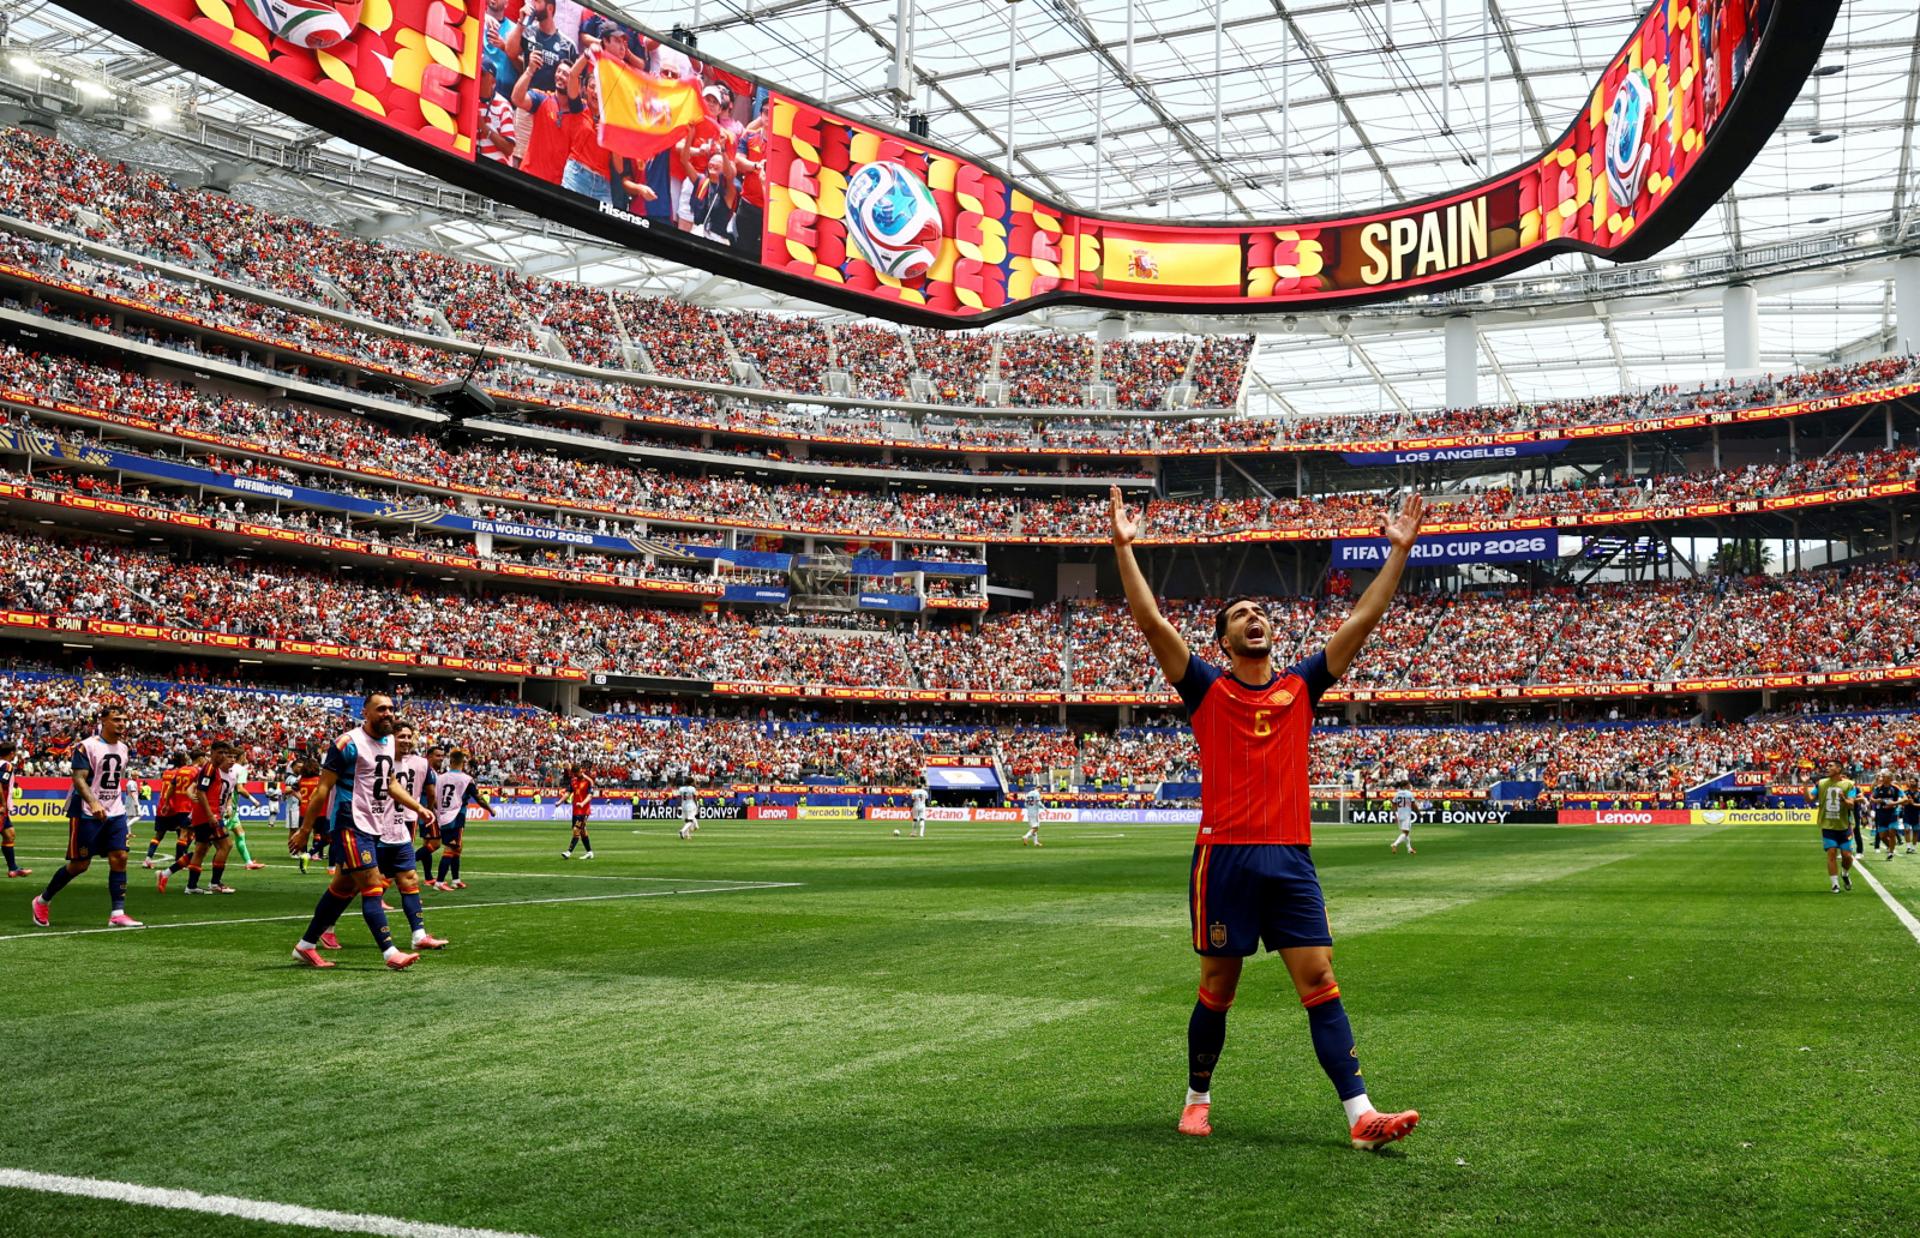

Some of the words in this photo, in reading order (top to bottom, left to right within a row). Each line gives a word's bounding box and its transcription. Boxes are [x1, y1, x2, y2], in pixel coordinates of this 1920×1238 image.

[599, 200, 650, 228] Hisense
[1360, 196, 1487, 285] SPAIN
[1540, 430, 1559, 440] SPAIN
[1634, 420, 1662, 432] GOAL!
[1711, 412, 1733, 424] SPAIN
[1810, 397, 1839, 411] GOAL!
[1396, 452, 1430, 464] LOS
[1433, 447, 1517, 461] ANGELES
[233, 478, 293, 499] #FIFAWorldCup
[32, 489, 55, 502] SPAIN
[138, 508, 168, 522] GOAL!
[215, 521, 236, 532] SPAIN
[1310, 528, 1339, 538] GOAL!
[1480, 520, 1509, 530] GOAL!
[1556, 516, 1578, 526] SPAIN
[1655, 507, 1685, 518] GOAL!
[1735, 500, 1759, 512] SPAIN
[1837, 486, 1867, 500] GOAL!
[472, 520, 494, 533] FIFA
[495, 522, 533, 537] WORLD
[535, 529, 556, 540] CUP
[557, 532, 593, 544] 2026
[1343, 546, 1379, 560] FIFA
[1447, 542, 1482, 556] CUP
[1484, 538, 1546, 555] 2026
[55, 618, 82, 631] SPAIN
[171, 629, 203, 643] GOAL!
[255, 638, 276, 650] SPAIN
[350, 648, 377, 661] GOAL!
[420, 655, 439, 666] SPAIN
[1501, 687, 1519, 696] SPAIN
[1653, 683, 1673, 692] SPAIN
[1807, 674, 1826, 684] SPAIN
[1065, 695, 1082, 703] SPAIN
[1254, 709, 1272, 737] 6
[176, 776, 190, 794] 22
[1736, 773, 1762, 785] GOAL!
[504, 805, 546, 818] kraken
[640, 806, 682, 819] MARRIO
[700, 807, 739, 819] BONVOY
[758, 806, 788, 819] Lenovo
[871, 808, 911, 819] Betano
[975, 809, 1017, 821] Betano
[1038, 809, 1072, 821] etano
[1092, 809, 1138, 821] kraken
[1442, 811, 1507, 823] BONVOY
[1596, 811, 1652, 824] Lenovo
[1728, 811, 1783, 822] mercado
[1785, 811, 1811, 822] libre
